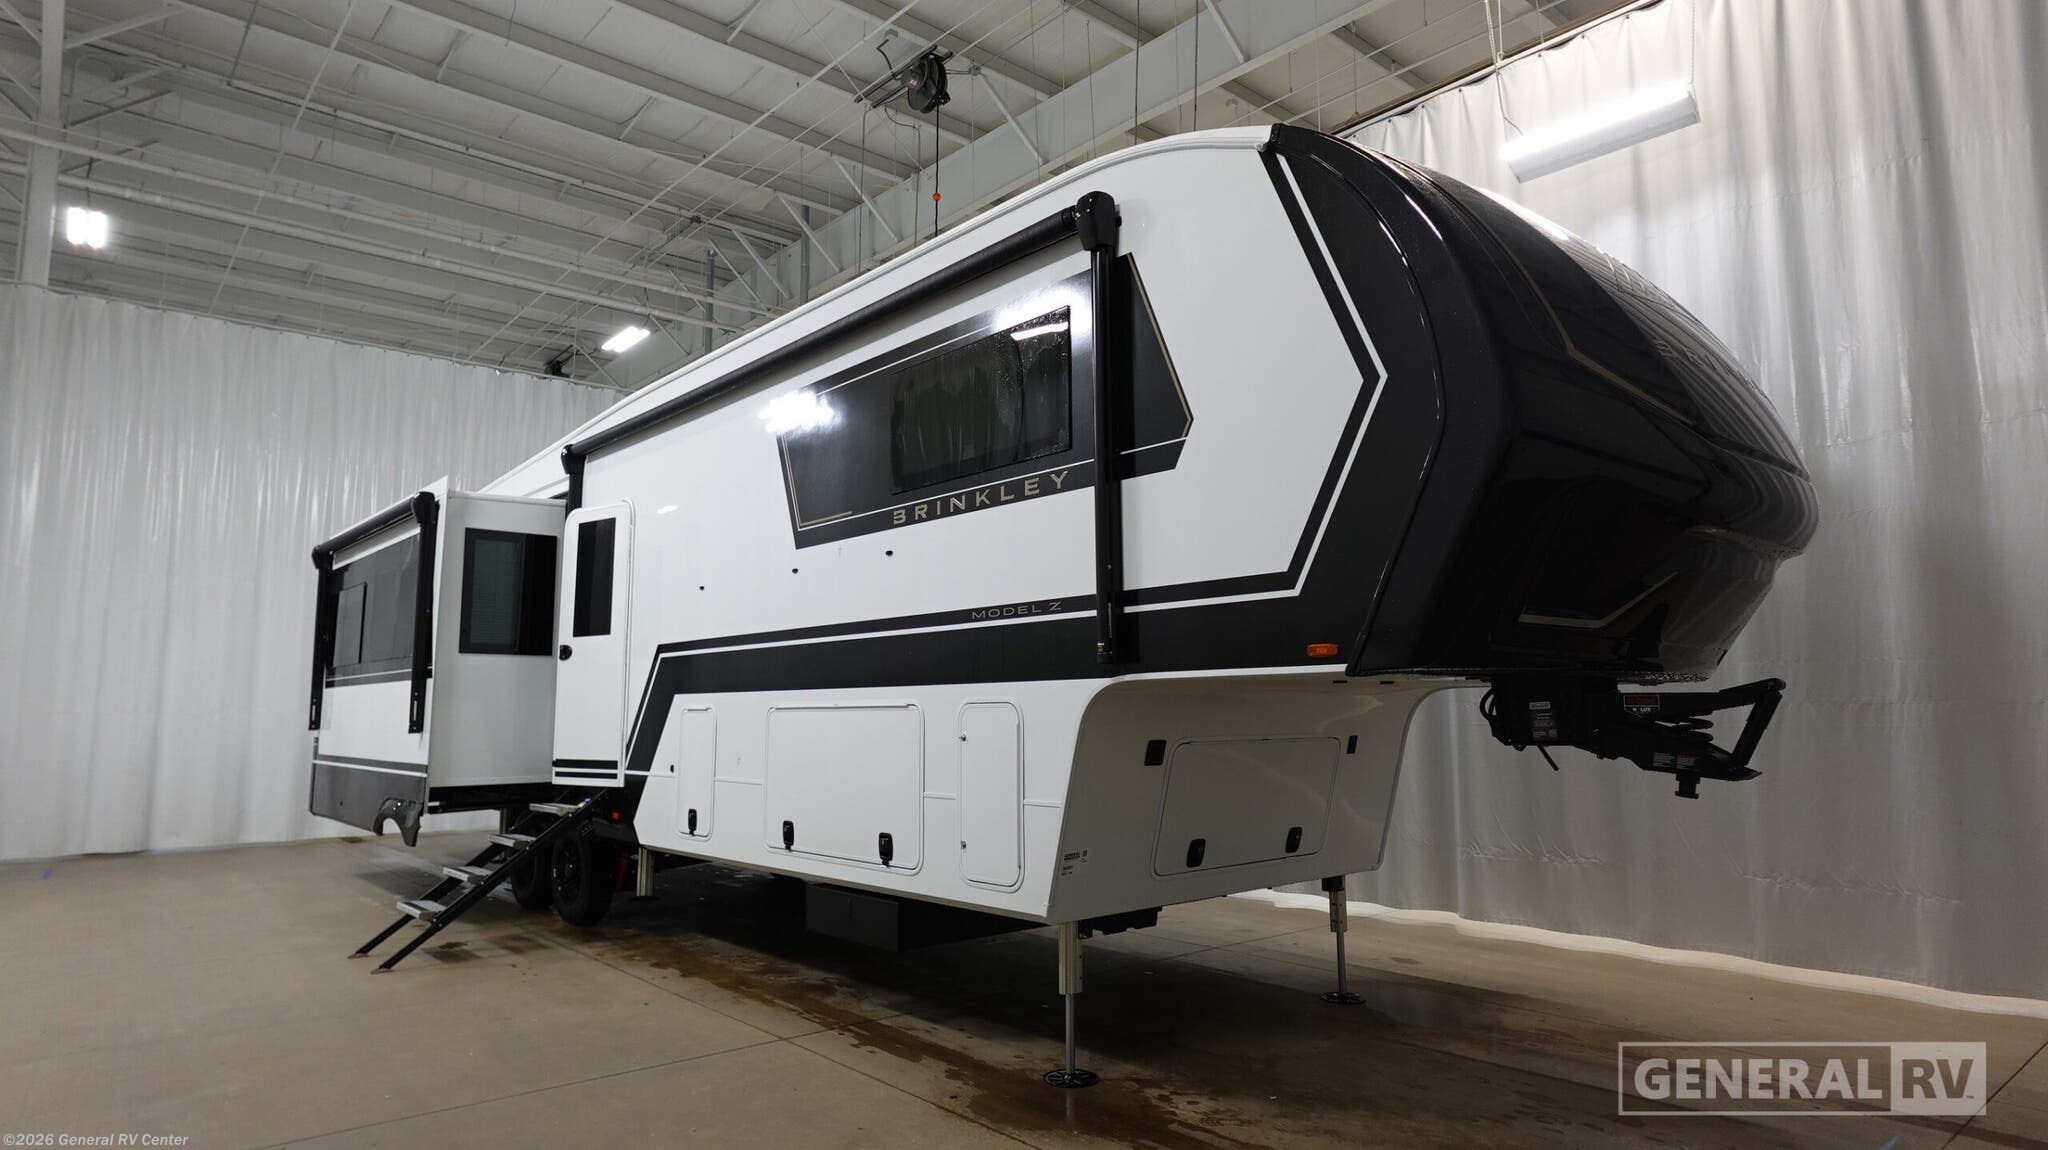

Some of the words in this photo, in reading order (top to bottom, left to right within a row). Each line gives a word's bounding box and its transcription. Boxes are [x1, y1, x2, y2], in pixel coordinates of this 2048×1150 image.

[893, 470, 1068, 525] BRINKLEY
[971, 604, 1042, 619] MODEL
[1049, 601, 1062, 610] Z
